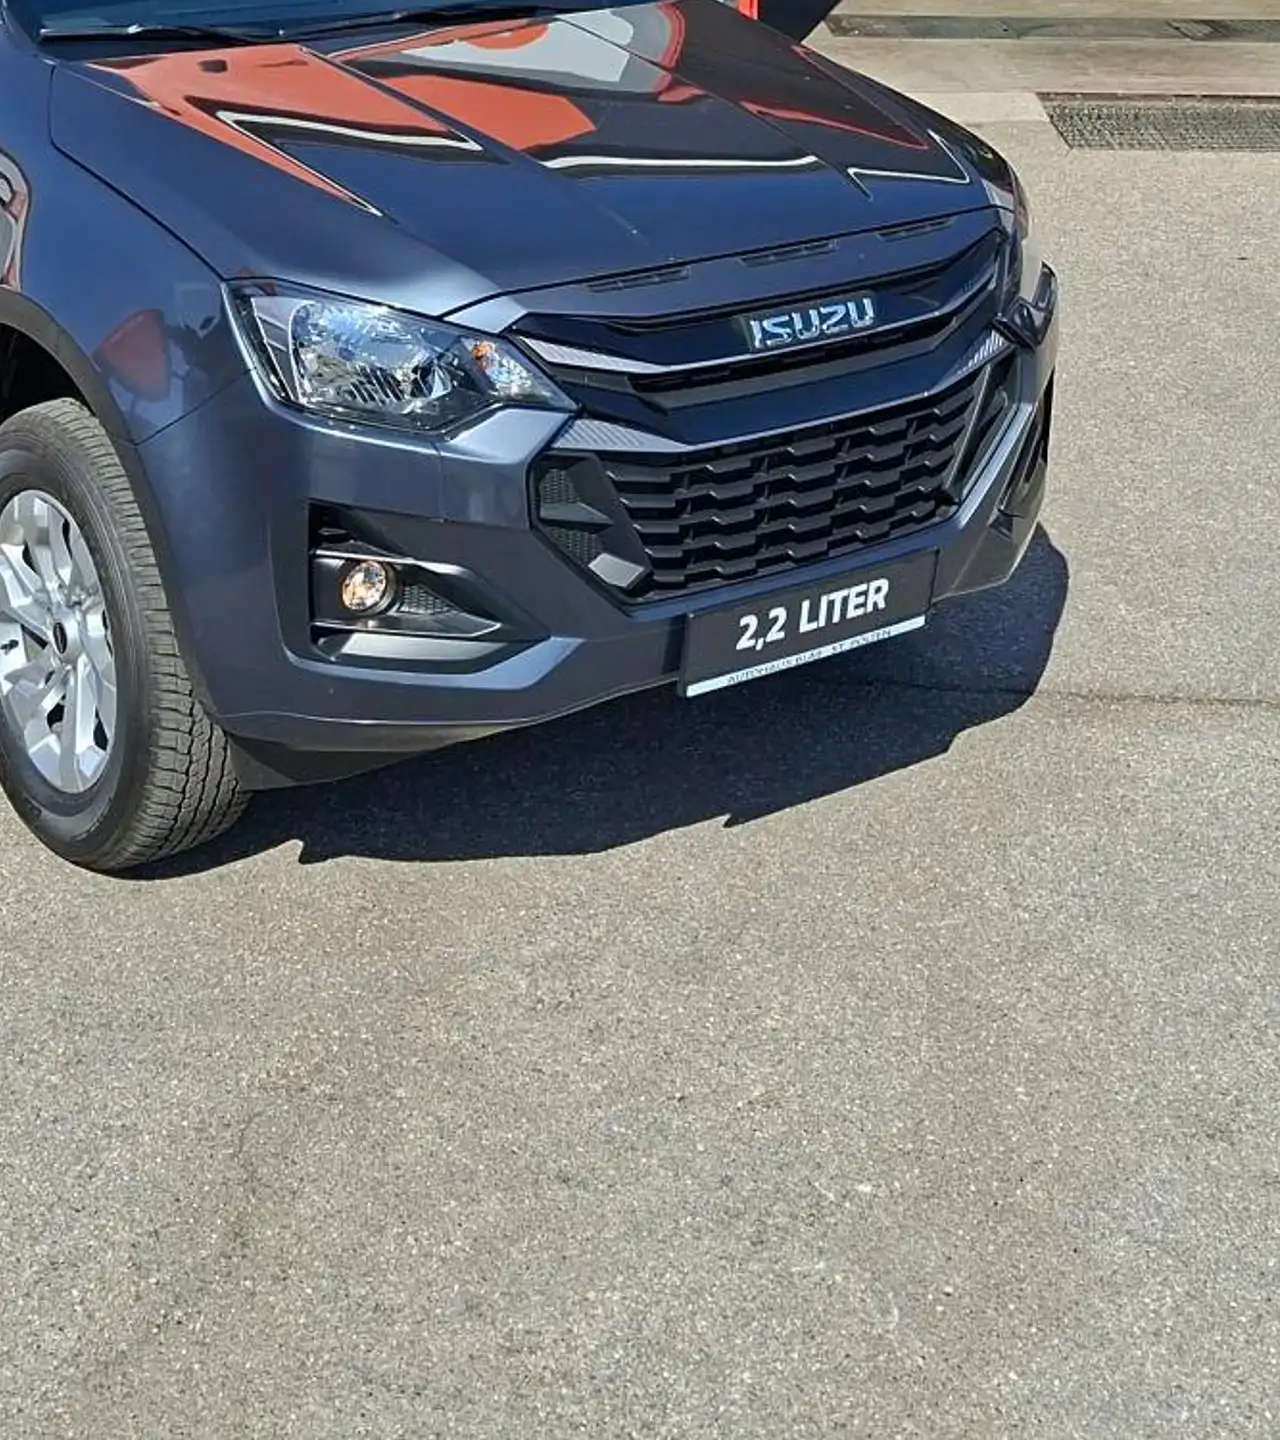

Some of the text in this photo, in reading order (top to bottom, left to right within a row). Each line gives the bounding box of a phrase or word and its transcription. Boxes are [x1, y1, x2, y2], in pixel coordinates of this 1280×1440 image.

[750, 297, 875, 349] ISUZU
[736, 578, 889, 650] 2,2 LITER
